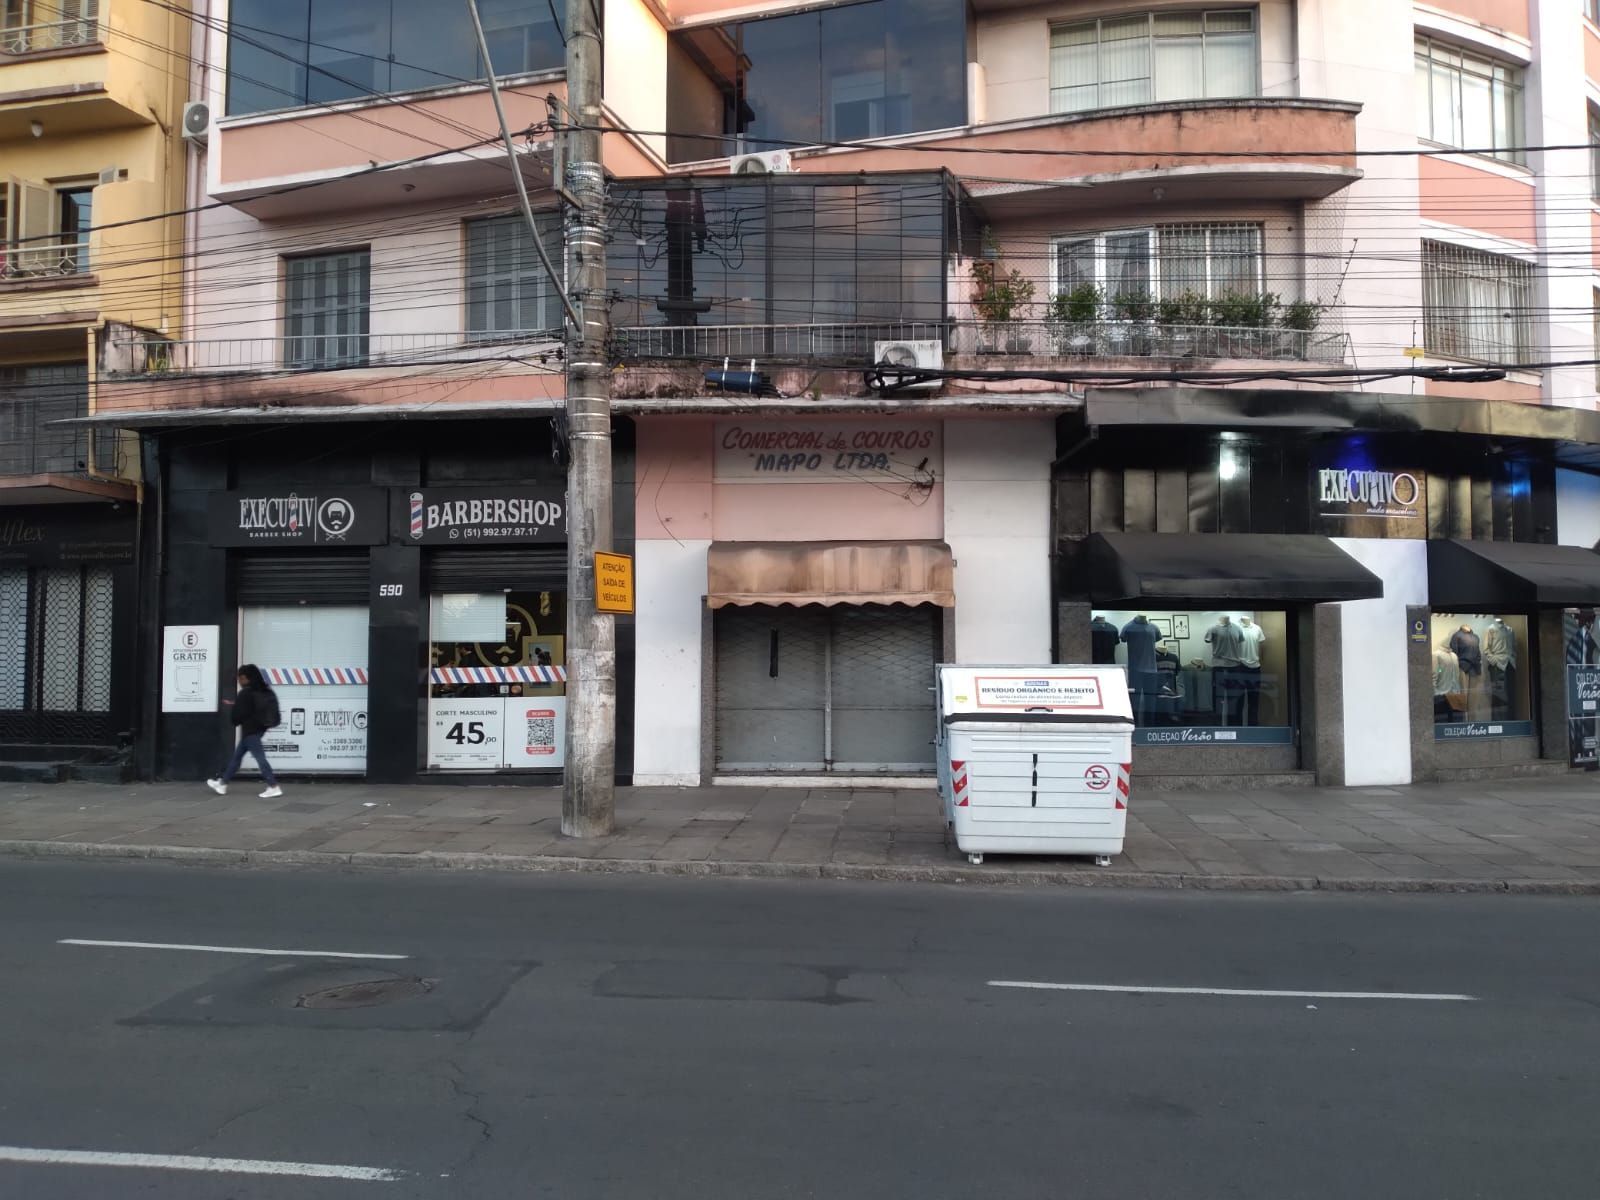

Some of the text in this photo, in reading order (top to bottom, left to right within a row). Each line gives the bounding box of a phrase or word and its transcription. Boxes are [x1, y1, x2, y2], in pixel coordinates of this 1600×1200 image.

[722, 427, 934, 450] COMERCIAL de COUROS
[1319, 468, 1419, 507] EXECUTIVO
[427, 499, 562, 529] BARBERSHOP
[463, 527, 539, 539] (51) 992.97.97.17
[602, 562, 626, 573] ATENÇÃO
[618, 579, 626, 588] DE
[379, 584, 403, 597] 590
[602, 591, 627, 603] VEÍCULOS
